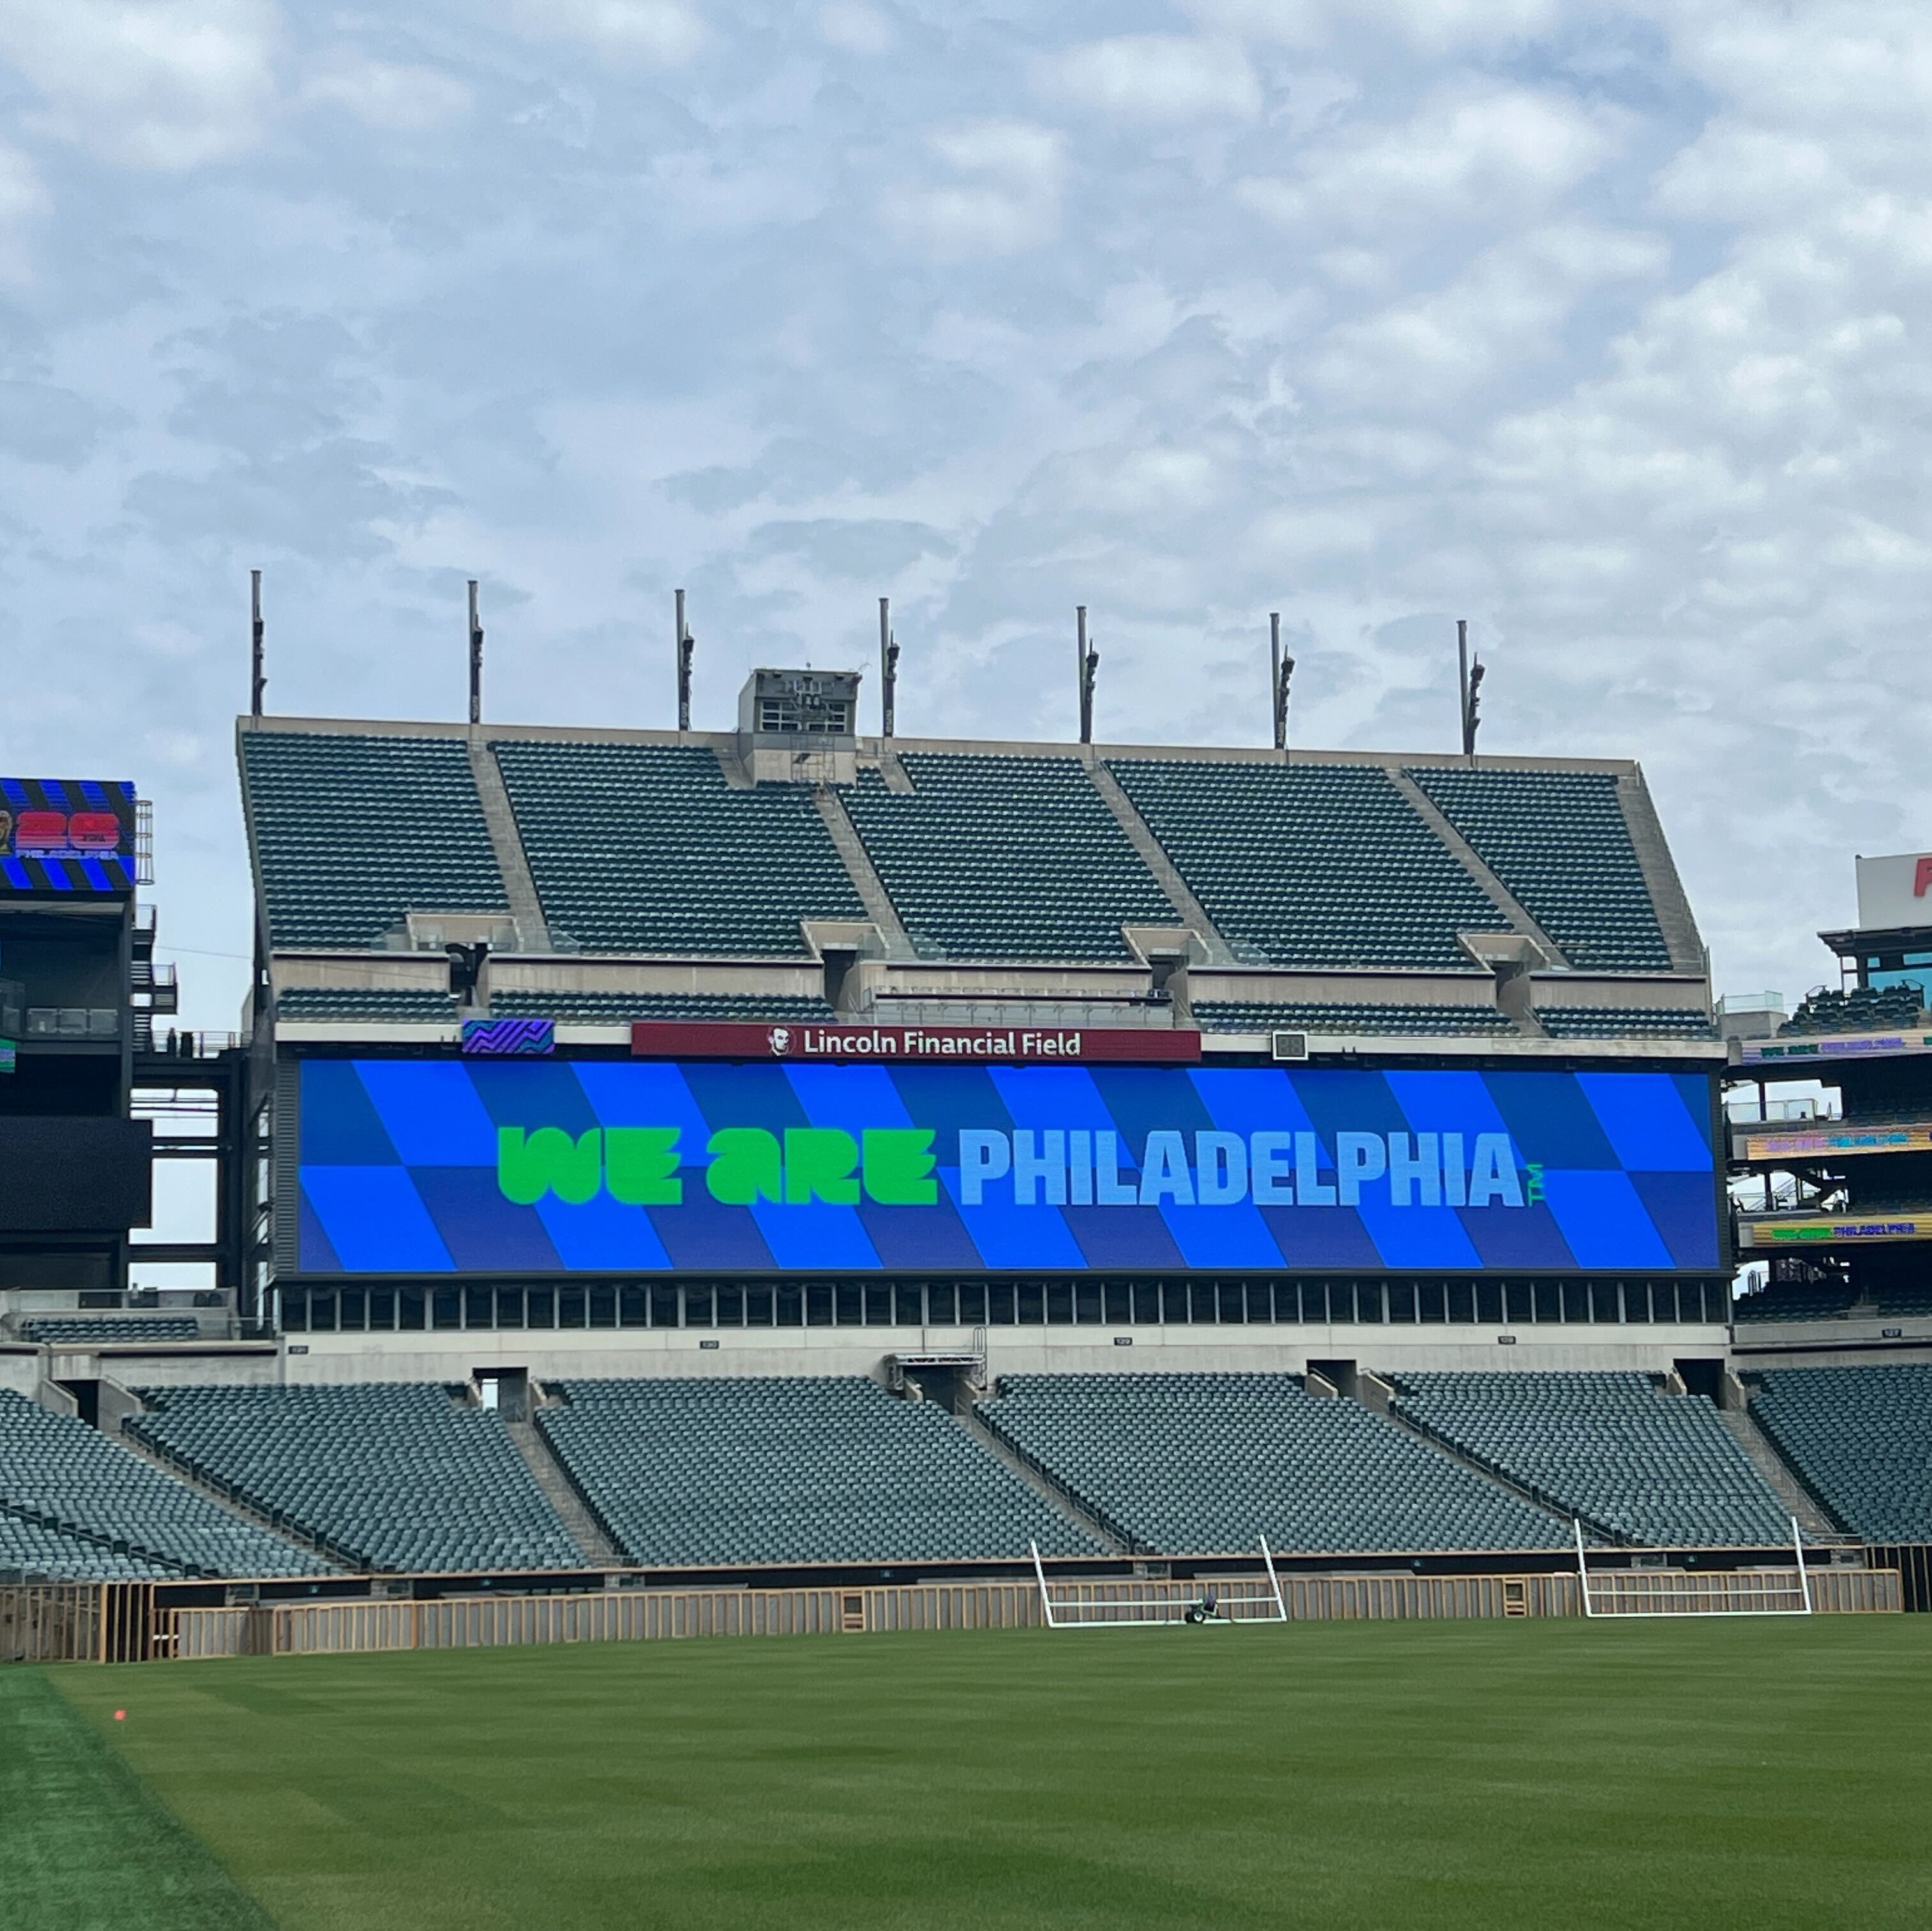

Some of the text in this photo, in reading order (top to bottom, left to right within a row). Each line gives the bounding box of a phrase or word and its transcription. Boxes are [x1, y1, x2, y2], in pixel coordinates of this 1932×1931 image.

[803, 1029, 1081, 1056] Lincoln Financial Field
[497, 1126, 1544, 1208] WE ARE PHILADELPHIA TM
